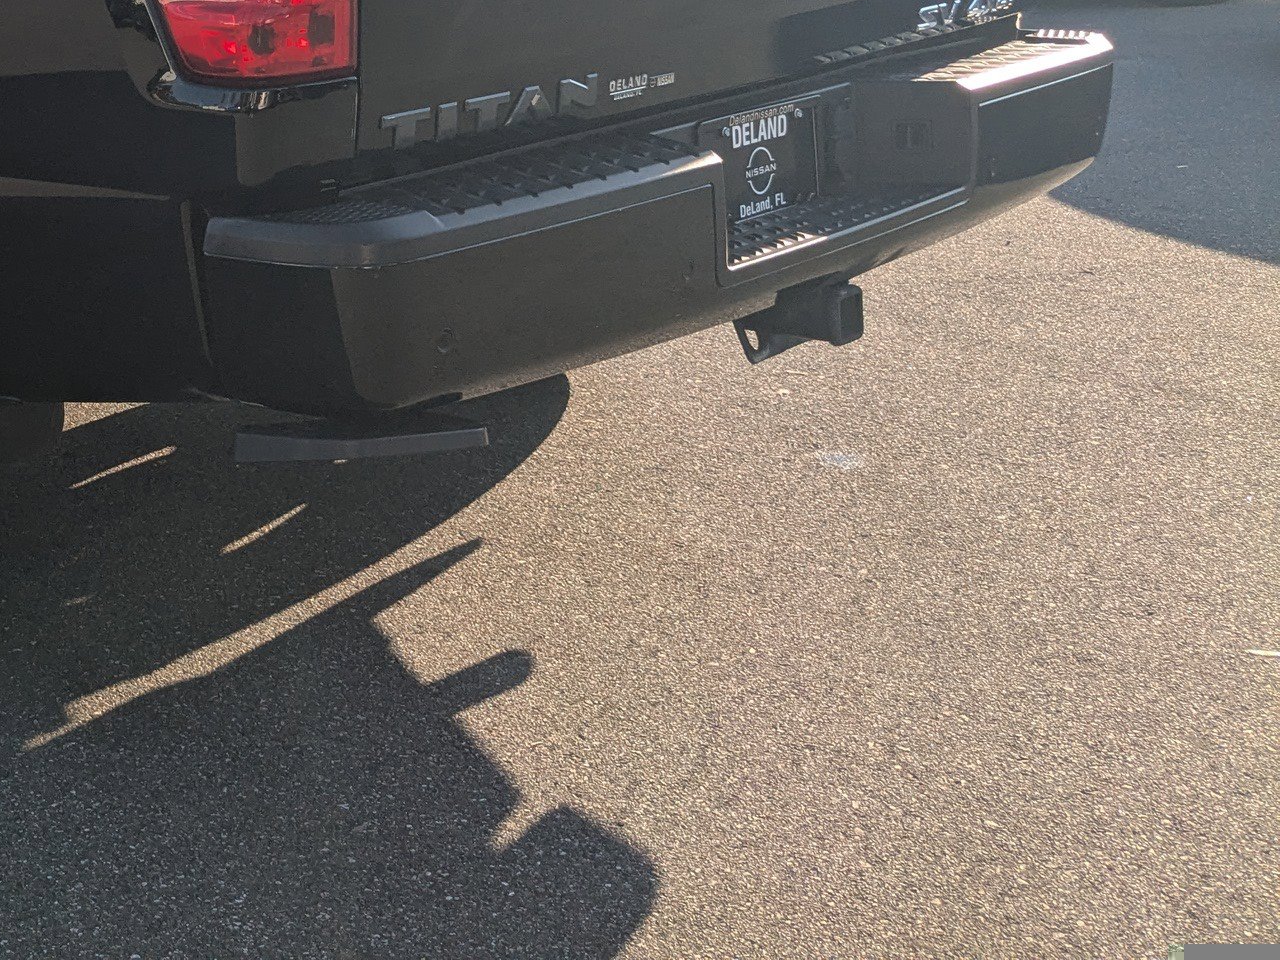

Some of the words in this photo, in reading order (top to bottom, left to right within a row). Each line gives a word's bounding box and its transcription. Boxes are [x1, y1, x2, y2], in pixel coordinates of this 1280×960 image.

[917, 0, 961, 30] SV
[609, 74, 648, 92] DELAND
[656, 72, 675, 87] NISSAN
[379, 73, 598, 150] TITAN
[728, 103, 795, 127] Delandnissan.com
[731, 114, 787, 149] DELAND
[745, 162, 777, 179] NISSAN
[739, 196, 774, 218] DeLand,
[774, 192, 787, 207] FL
